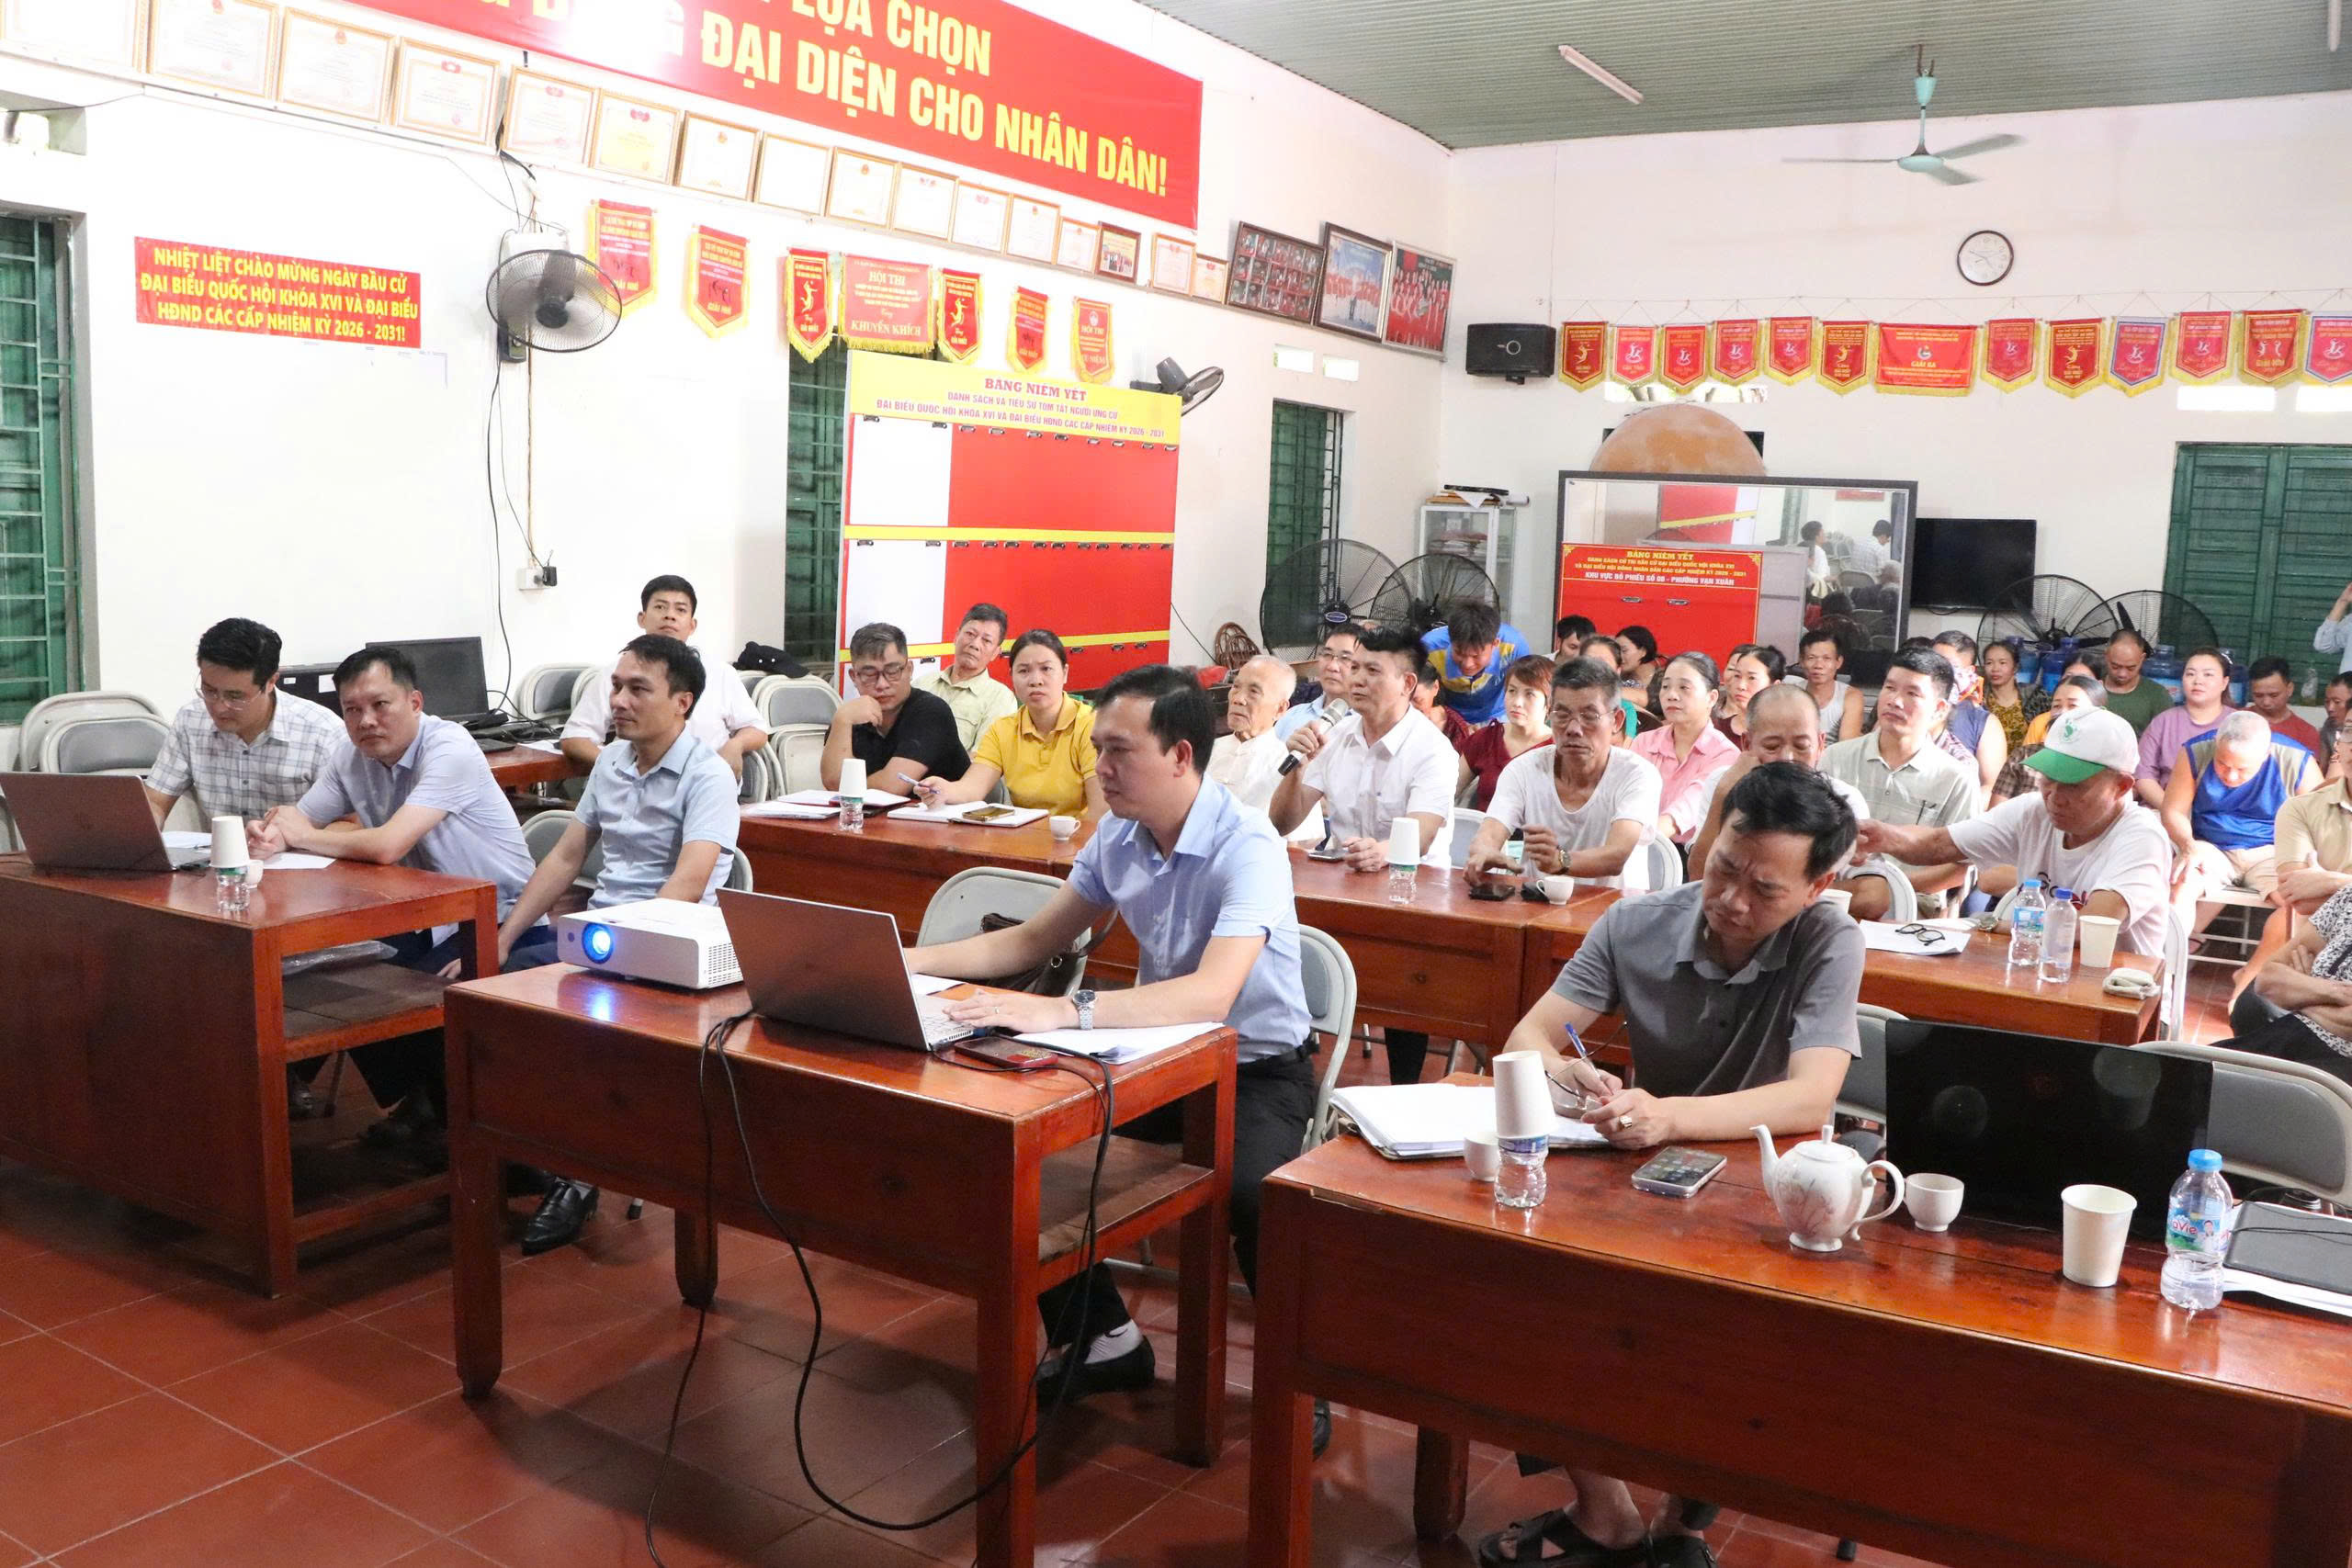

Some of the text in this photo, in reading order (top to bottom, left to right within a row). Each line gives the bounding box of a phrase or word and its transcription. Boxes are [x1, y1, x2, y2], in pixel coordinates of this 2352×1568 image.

[887, 0, 991, 77] CHỌN
[701, 10, 781, 89] ĐẠI
[797, 39, 897, 118] DIỆN
[910, 77, 984, 141] CHO
[996, 103, 1088, 174] NHÂN
[1097, 136, 1168, 197] DÂN!
[153, 246, 408, 295] NHIỆT LIỆT CHÀO MỪNG NGÀY BẦU CỬ
[868, 271, 906, 287] HỘI THI
[141, 272, 418, 321] ĐẠI BIỂU QUỐC HỘI KHÓA XVI VÀ ĐẠI BIỂU
[157, 302, 201, 323] HĐND
[205, 302, 232, 326] CÁC
[236, 305, 264, 329] CẤP
[267, 311, 311, 336] NHIỆM
[314, 313, 332, 334] KỲ
[334, 321, 364, 338] 2026
[374, 323, 405, 342] 2031!
